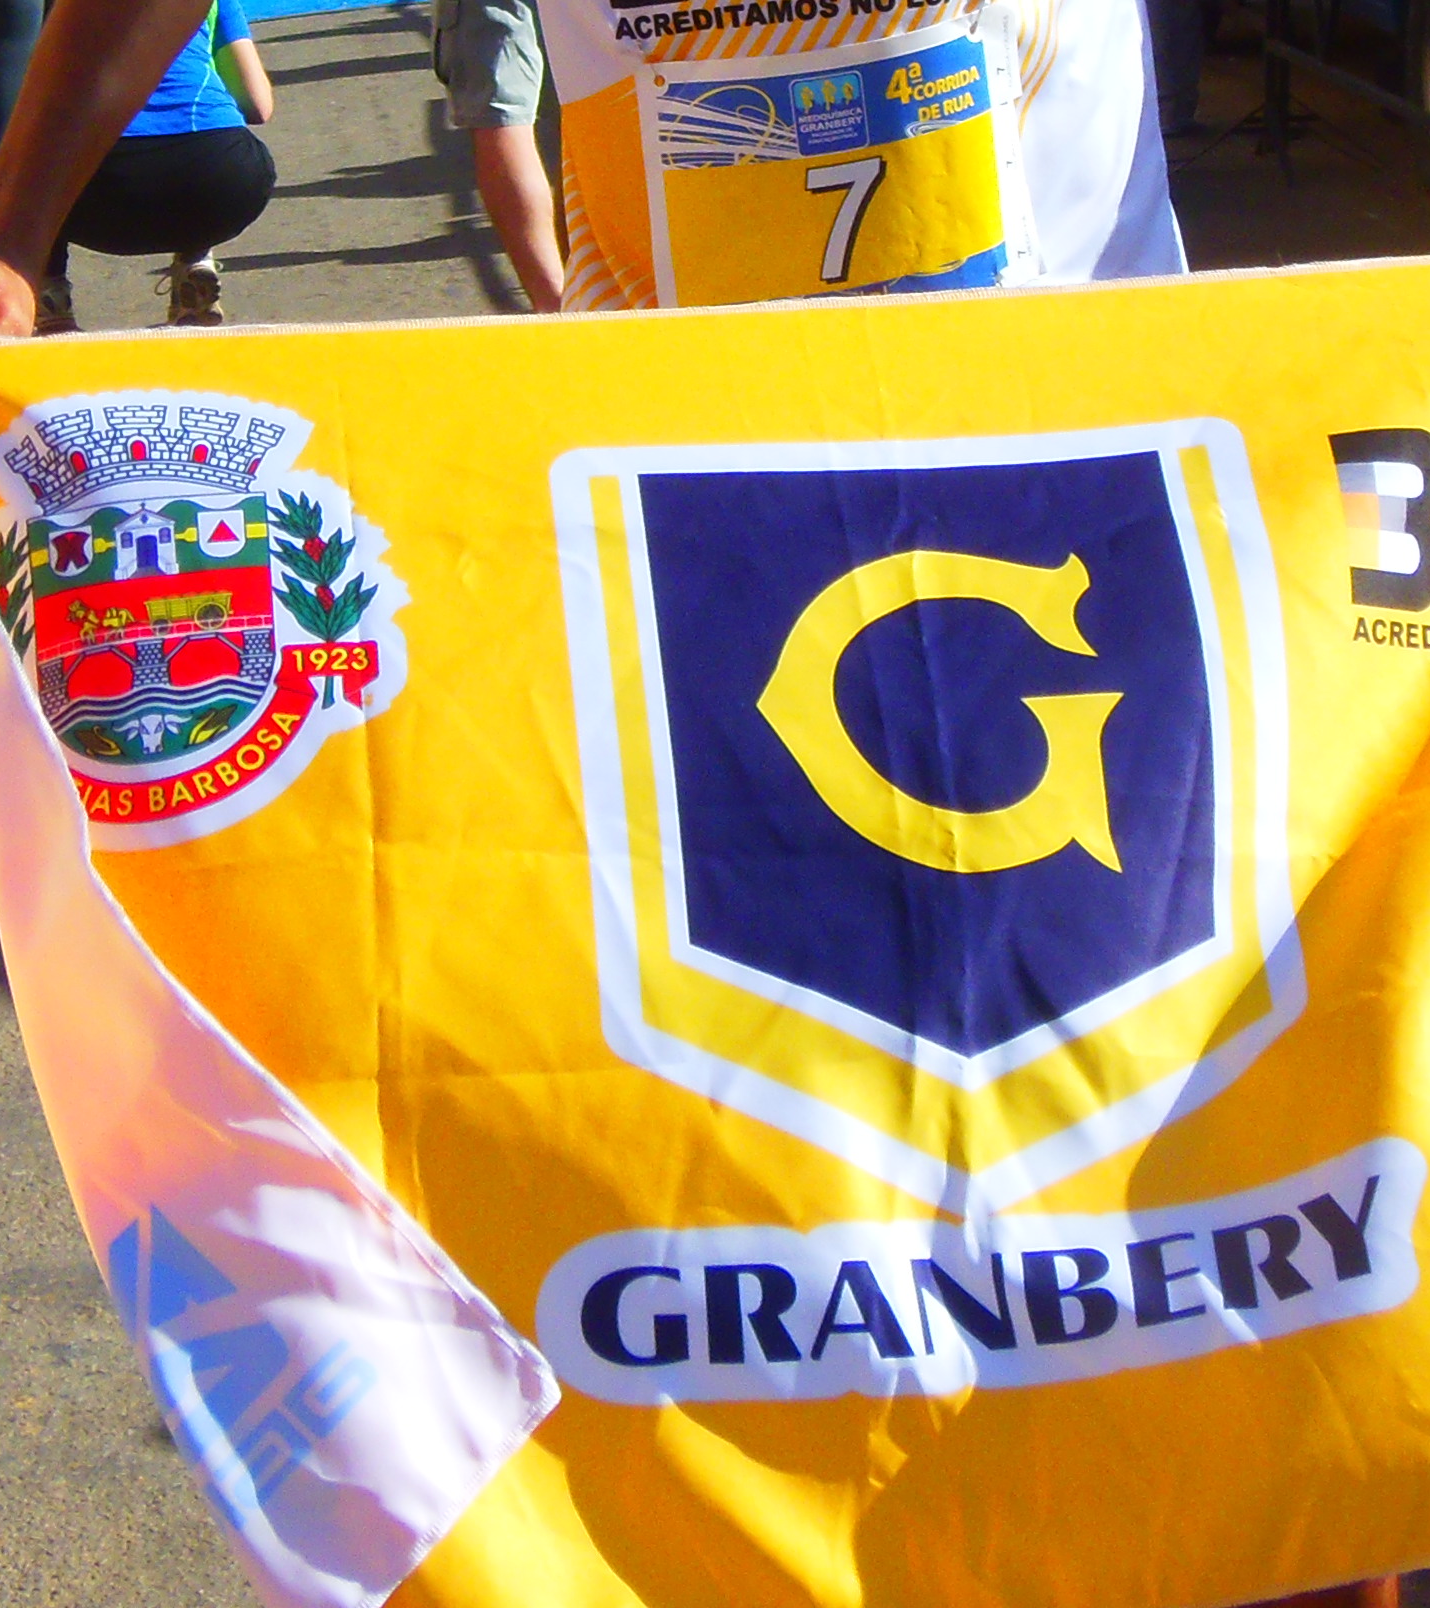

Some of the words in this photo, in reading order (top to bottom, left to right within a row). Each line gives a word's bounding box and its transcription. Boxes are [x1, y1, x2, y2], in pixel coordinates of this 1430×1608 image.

[912, 65, 981, 101] CORRIDA
[918, 103, 941, 122] DE
[943, 92, 975, 114] RUA
[800, 117, 862, 133] GRANBERY
[804, 155, 887, 284] 7
[293, 645, 369, 673] 1923
[757, 550, 1124, 874] G
[148, 710, 301, 814] BARBOSA
[580, 1175, 1380, 1369] GRANBERY
